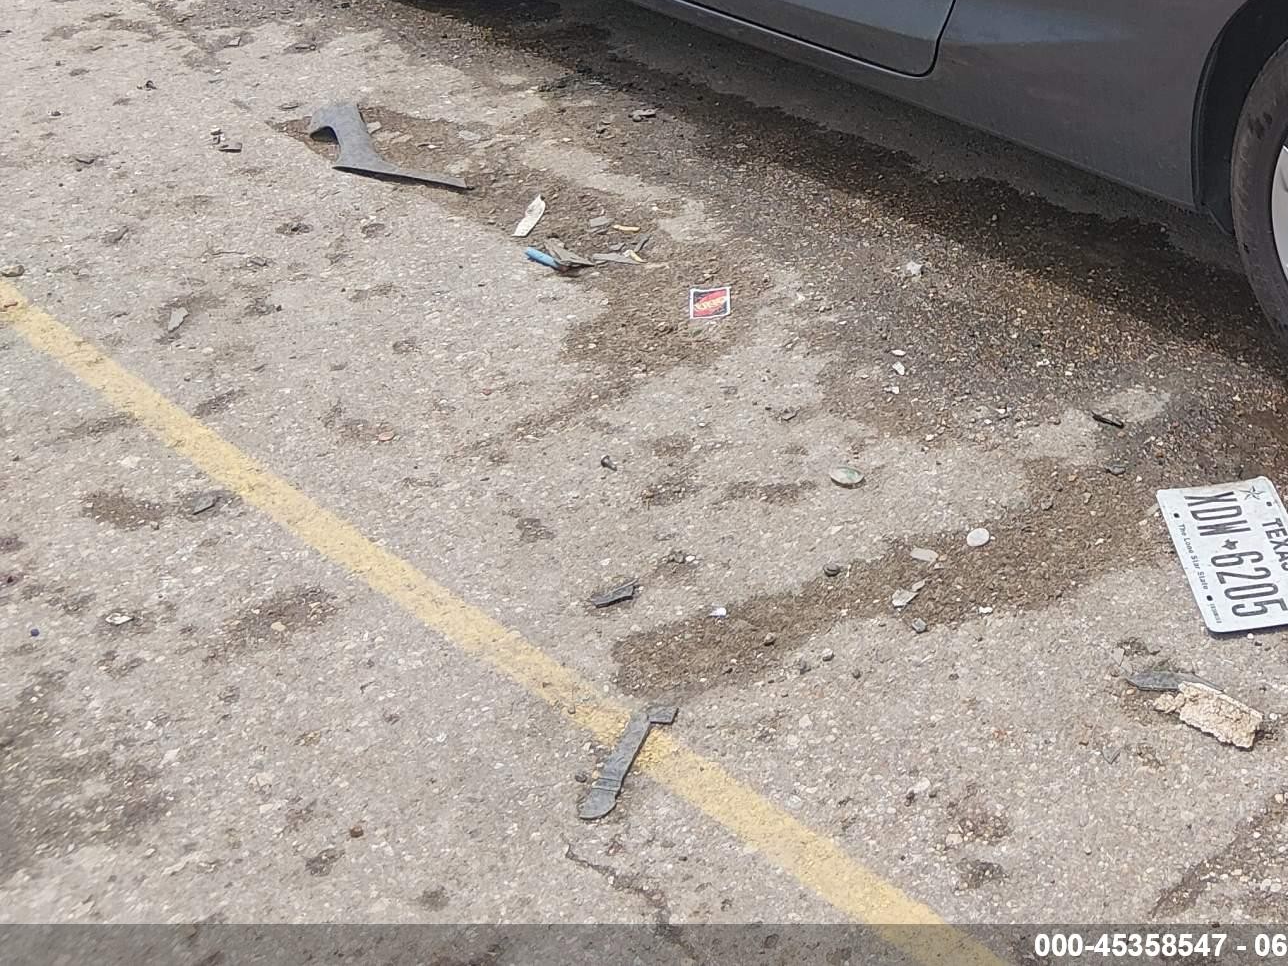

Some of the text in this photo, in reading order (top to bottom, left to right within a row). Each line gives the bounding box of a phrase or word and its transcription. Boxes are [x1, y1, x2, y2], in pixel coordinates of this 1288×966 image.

[1178, 523, 1209, 590] The Lone Star State
[1184, 491, 1288, 618] XDW 6205
